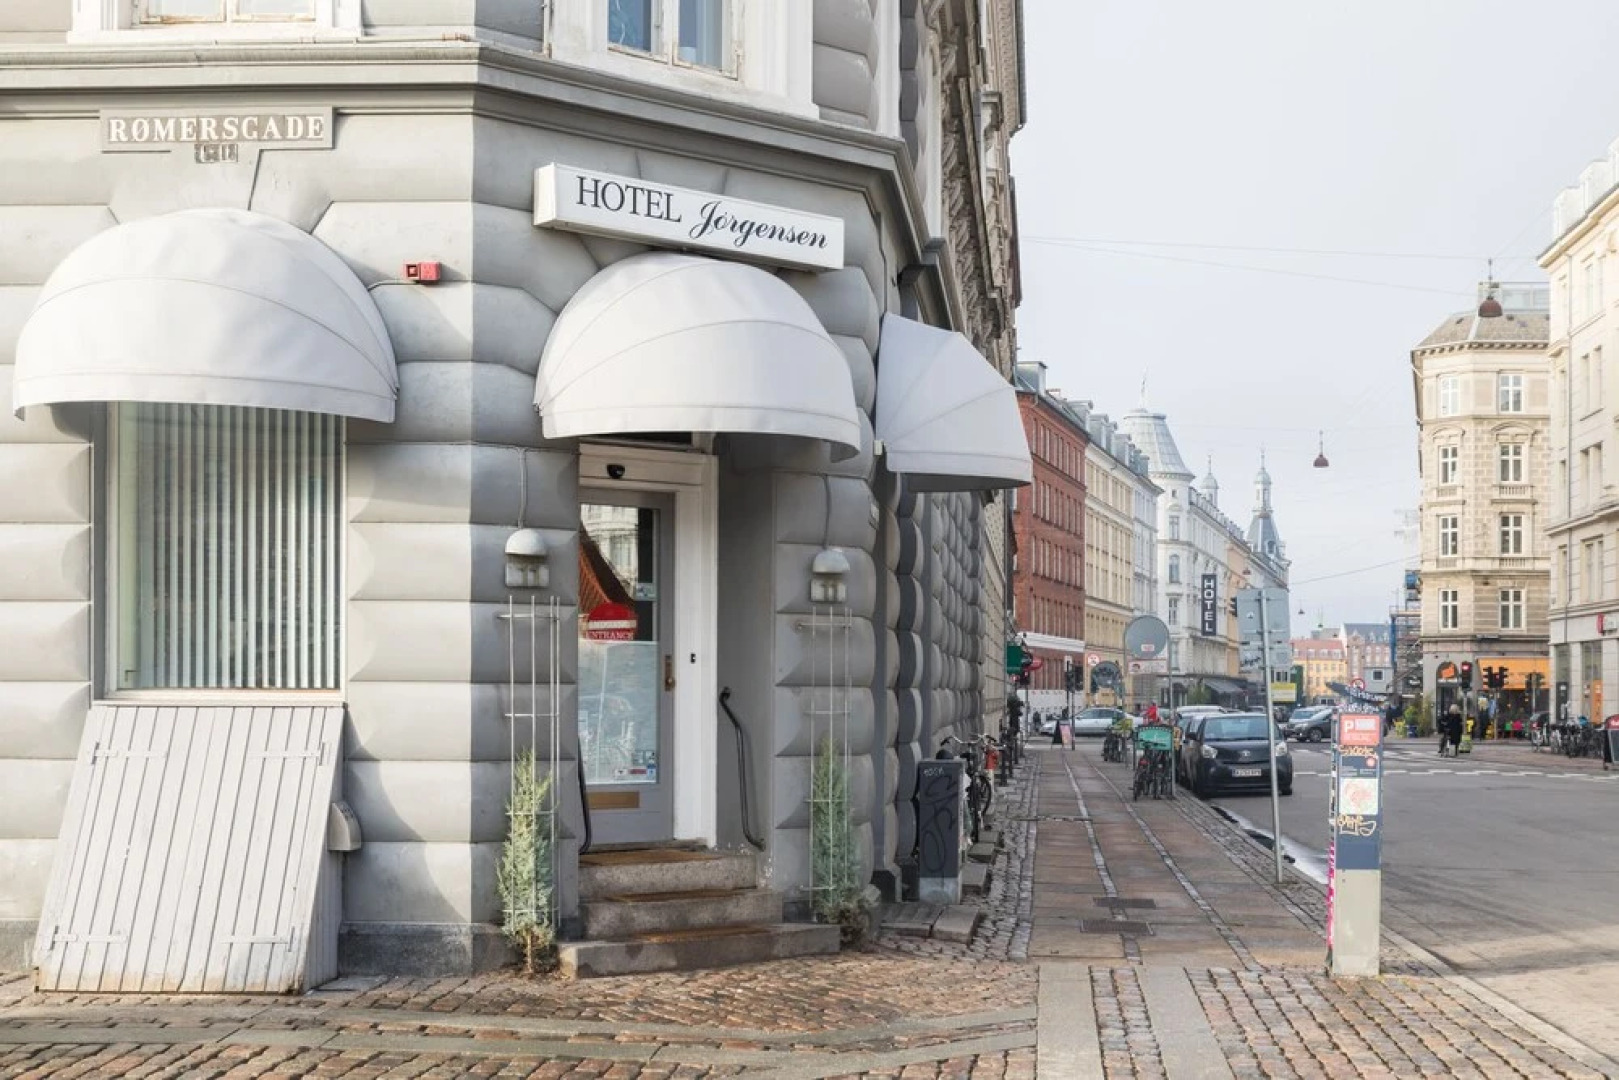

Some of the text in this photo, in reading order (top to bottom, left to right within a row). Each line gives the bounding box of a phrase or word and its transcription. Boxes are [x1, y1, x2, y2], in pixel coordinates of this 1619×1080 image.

[108, 115, 325, 142] RØMERSGADE
[576, 176, 682, 223] HOTEL
[1204, 579, 1215, 632] HOTEL
